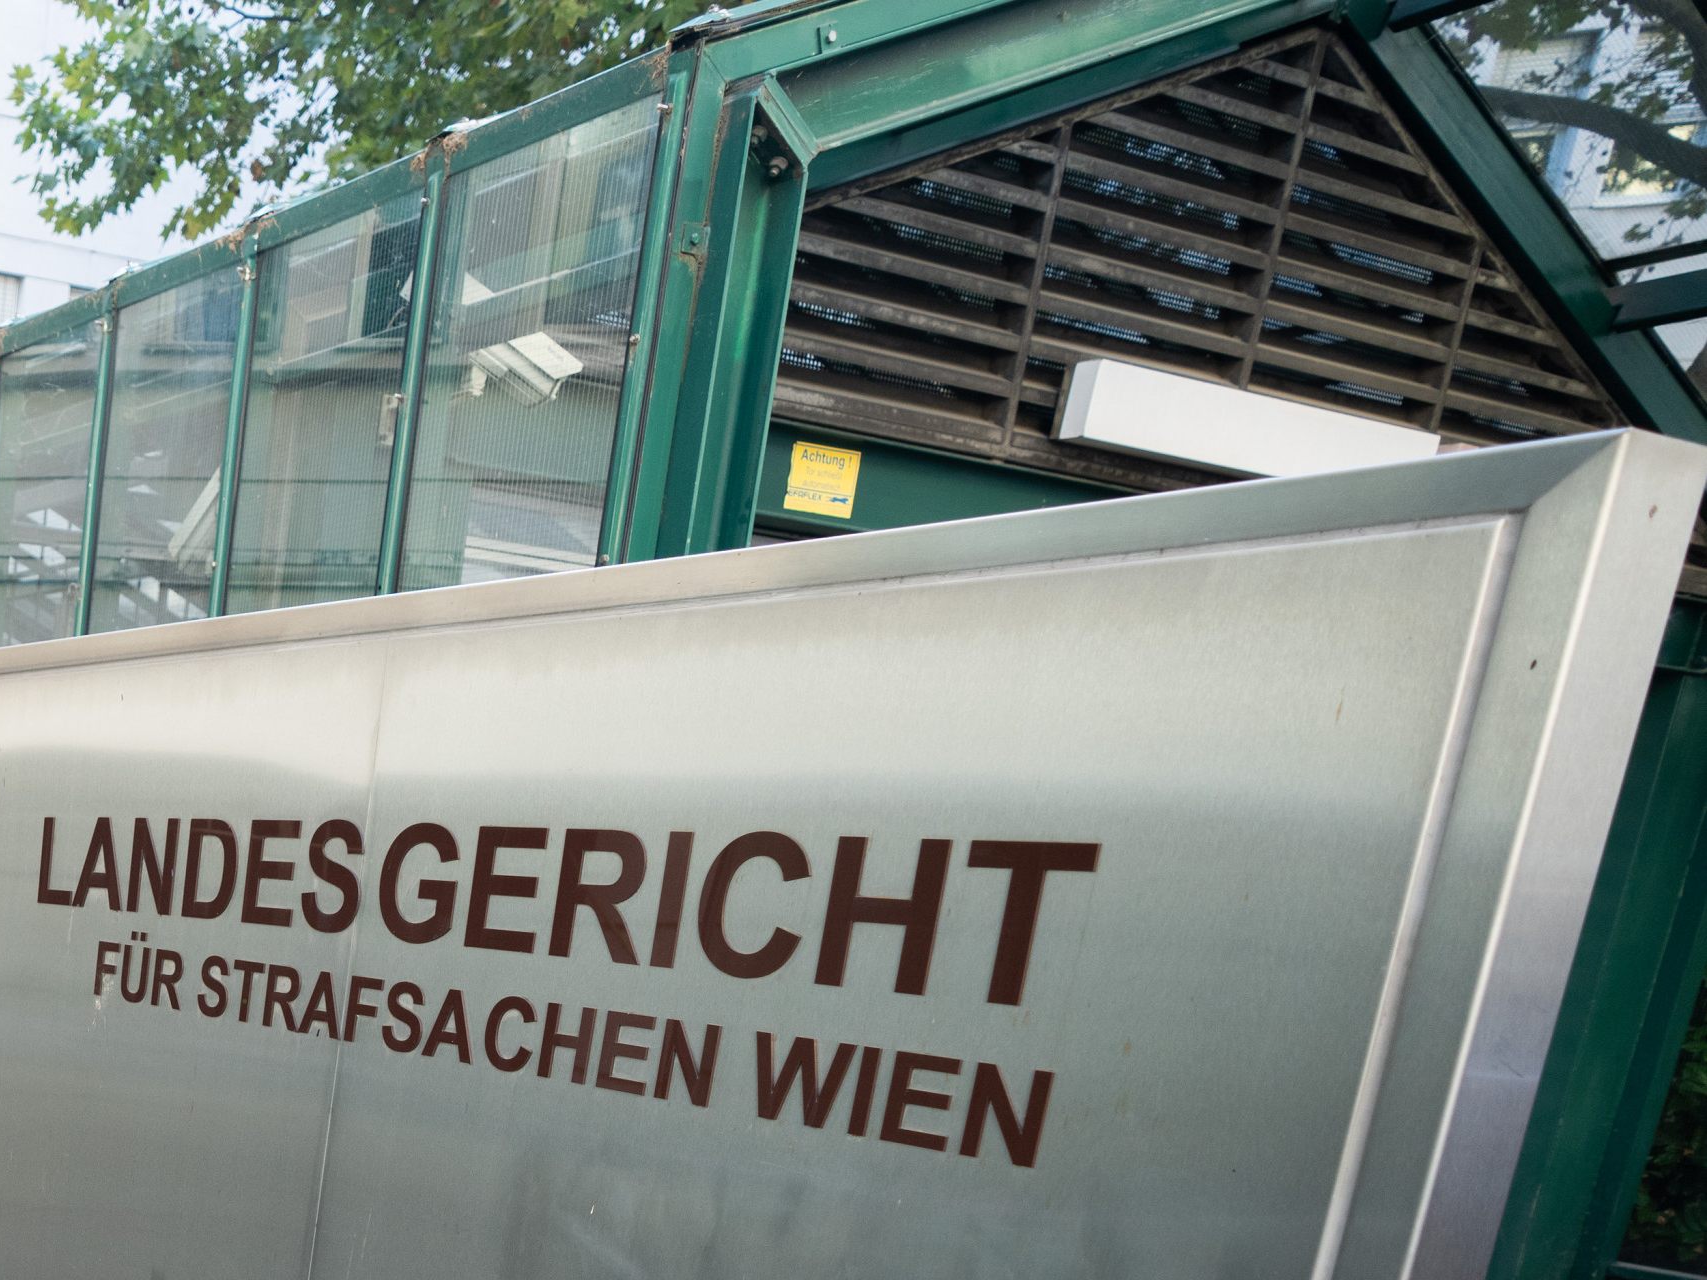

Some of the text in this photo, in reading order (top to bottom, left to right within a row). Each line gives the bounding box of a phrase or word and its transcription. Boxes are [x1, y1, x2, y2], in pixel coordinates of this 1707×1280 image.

[801, 449, 845, 470] Achtung
[36, 815, 1102, 1007] LANDESGERICHT
[93, 932, 1056, 1169] FÜR STRAFSACHEN WIEN
